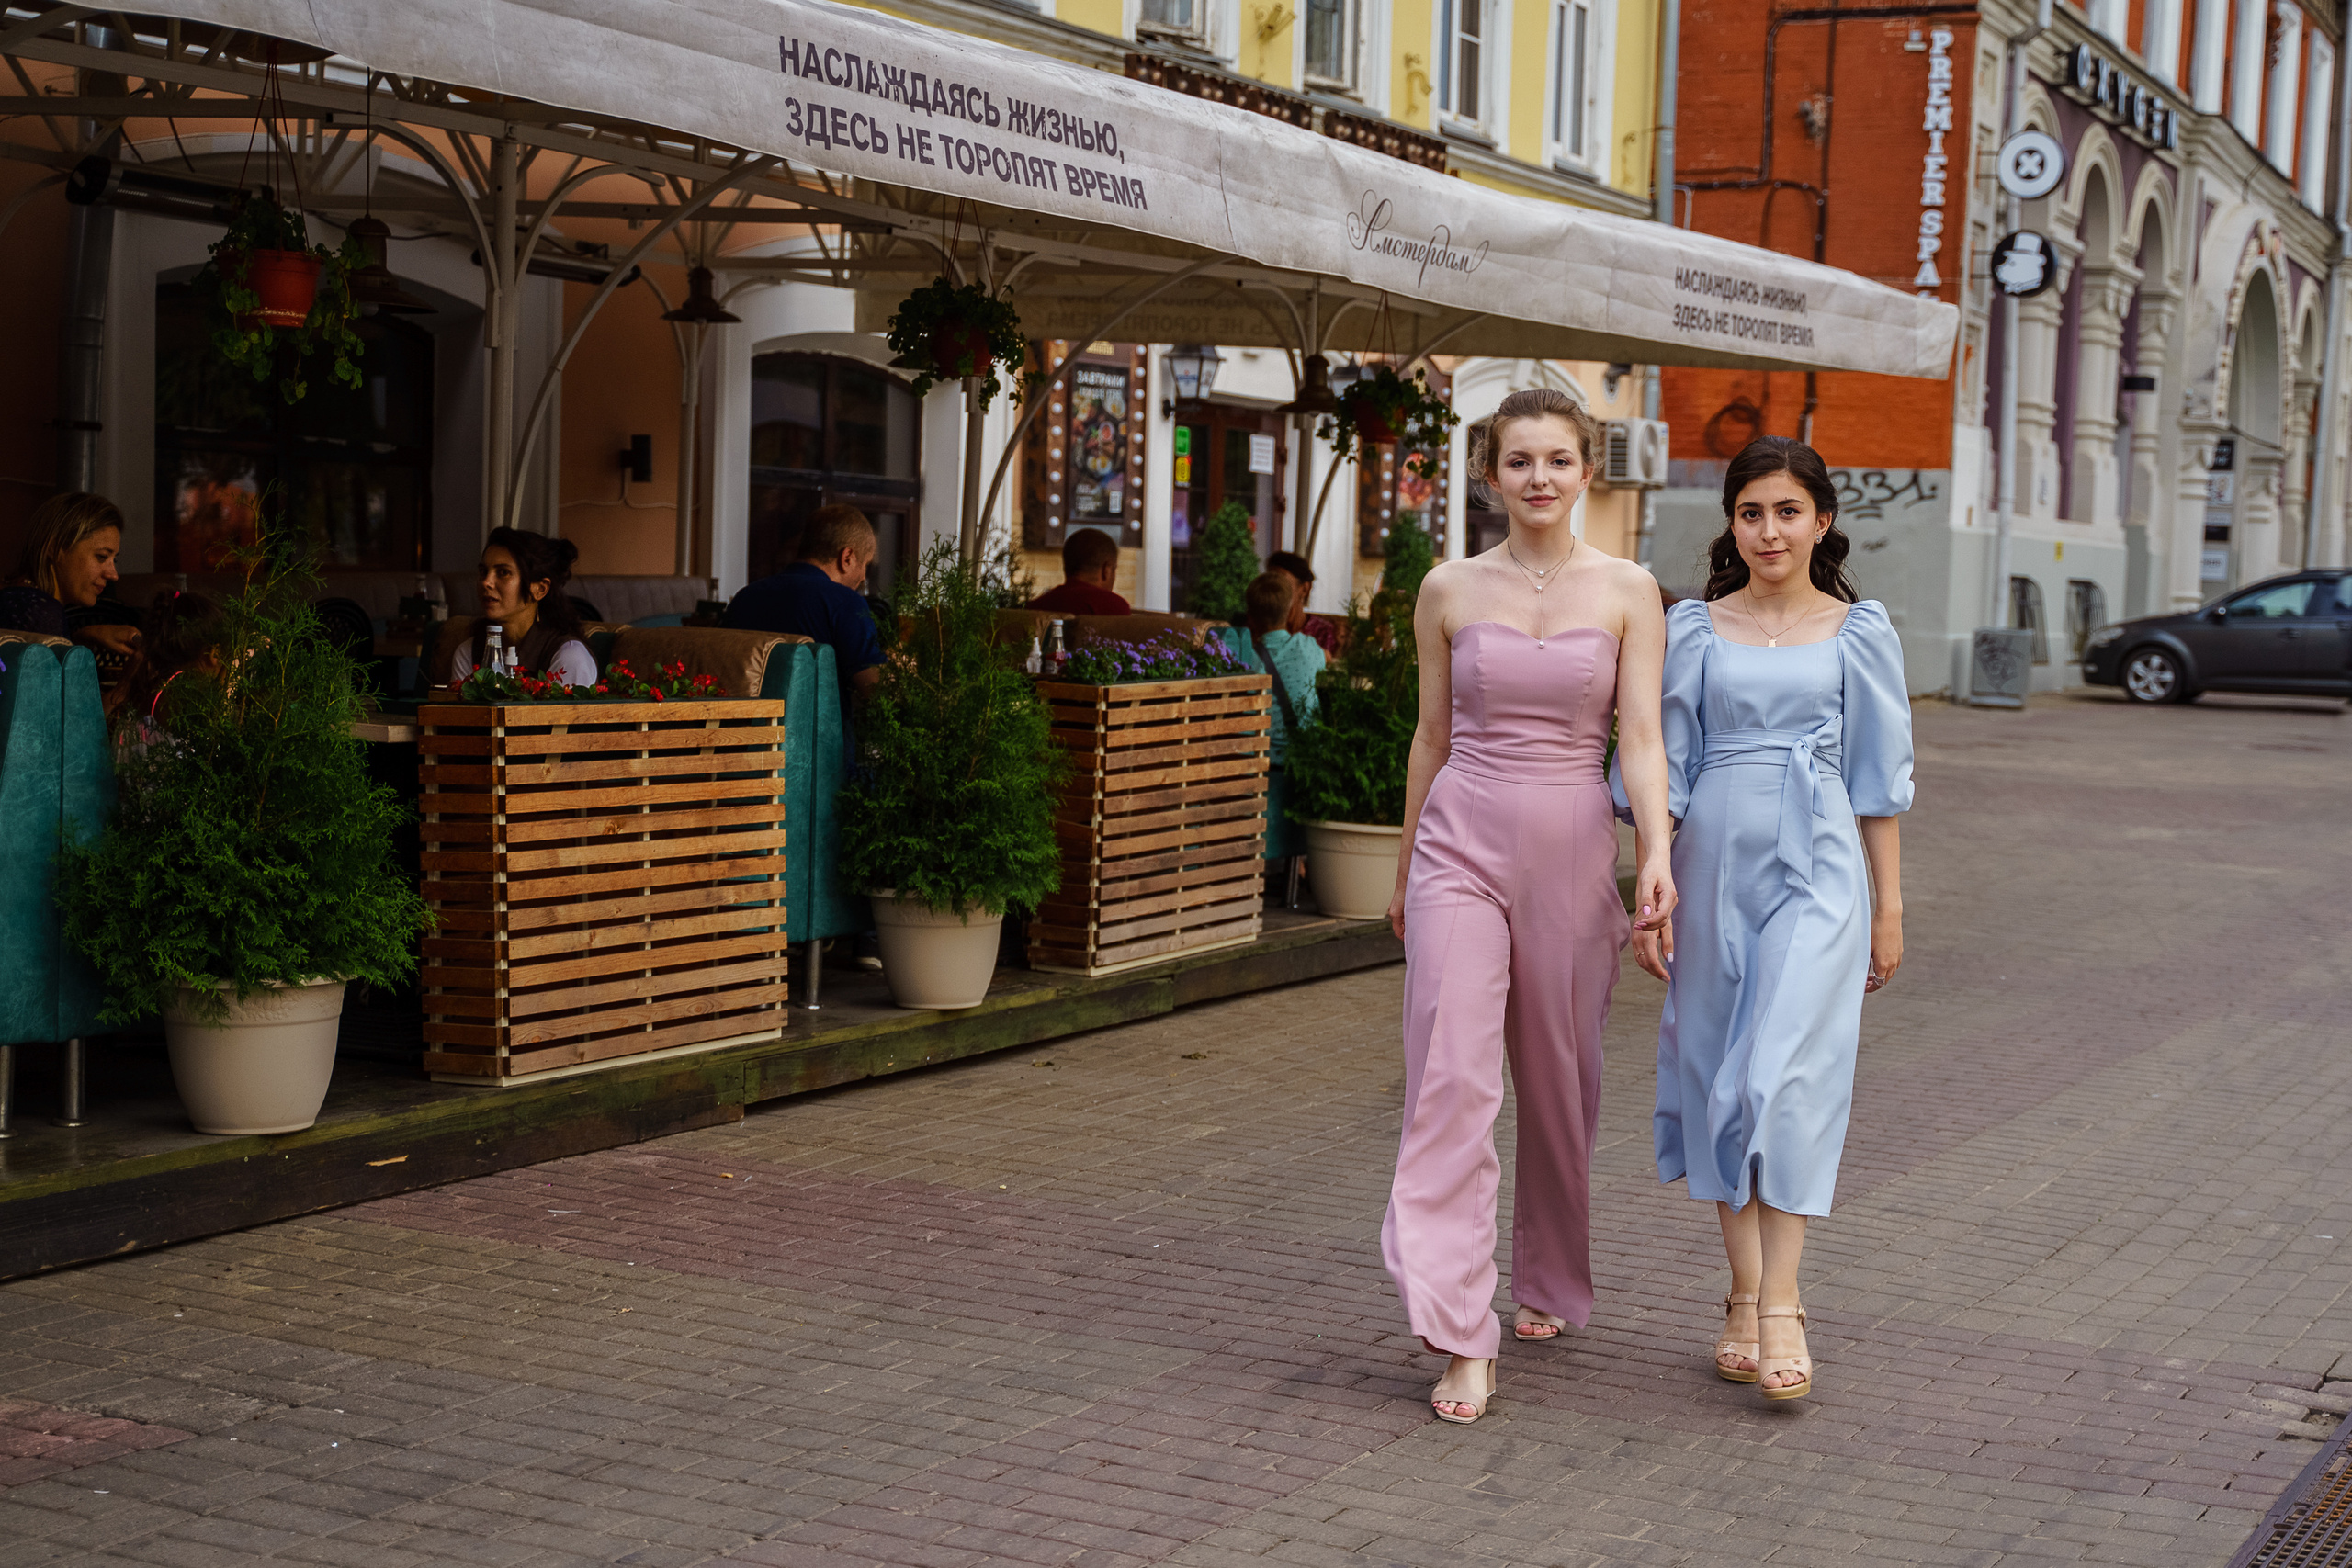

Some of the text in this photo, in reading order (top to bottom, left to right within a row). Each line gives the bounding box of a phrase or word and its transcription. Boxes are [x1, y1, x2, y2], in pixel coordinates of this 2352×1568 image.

[779, 35, 1125, 164] НАСЛАЖДАЯСЬ ЖИЗНЬЮ,
[1920, 29, 1954, 206] PREMIER
[784, 96, 1148, 210] ЗДЕСЬ НЕ ТОРОПЯТ ВРЕМЯ
[1347, 189, 1489, 288] Амстердам
[1672, 303, 1815, 348] ЗДЕСЬ НЕ ТОРОПЯТ ВРЕМЯ
[1674, 265, 1809, 318] НАСЛАЖДАЯСЬ ЖИЗНЬЮ,
[1077, 370, 1125, 388] ЗАВТРАКИ
